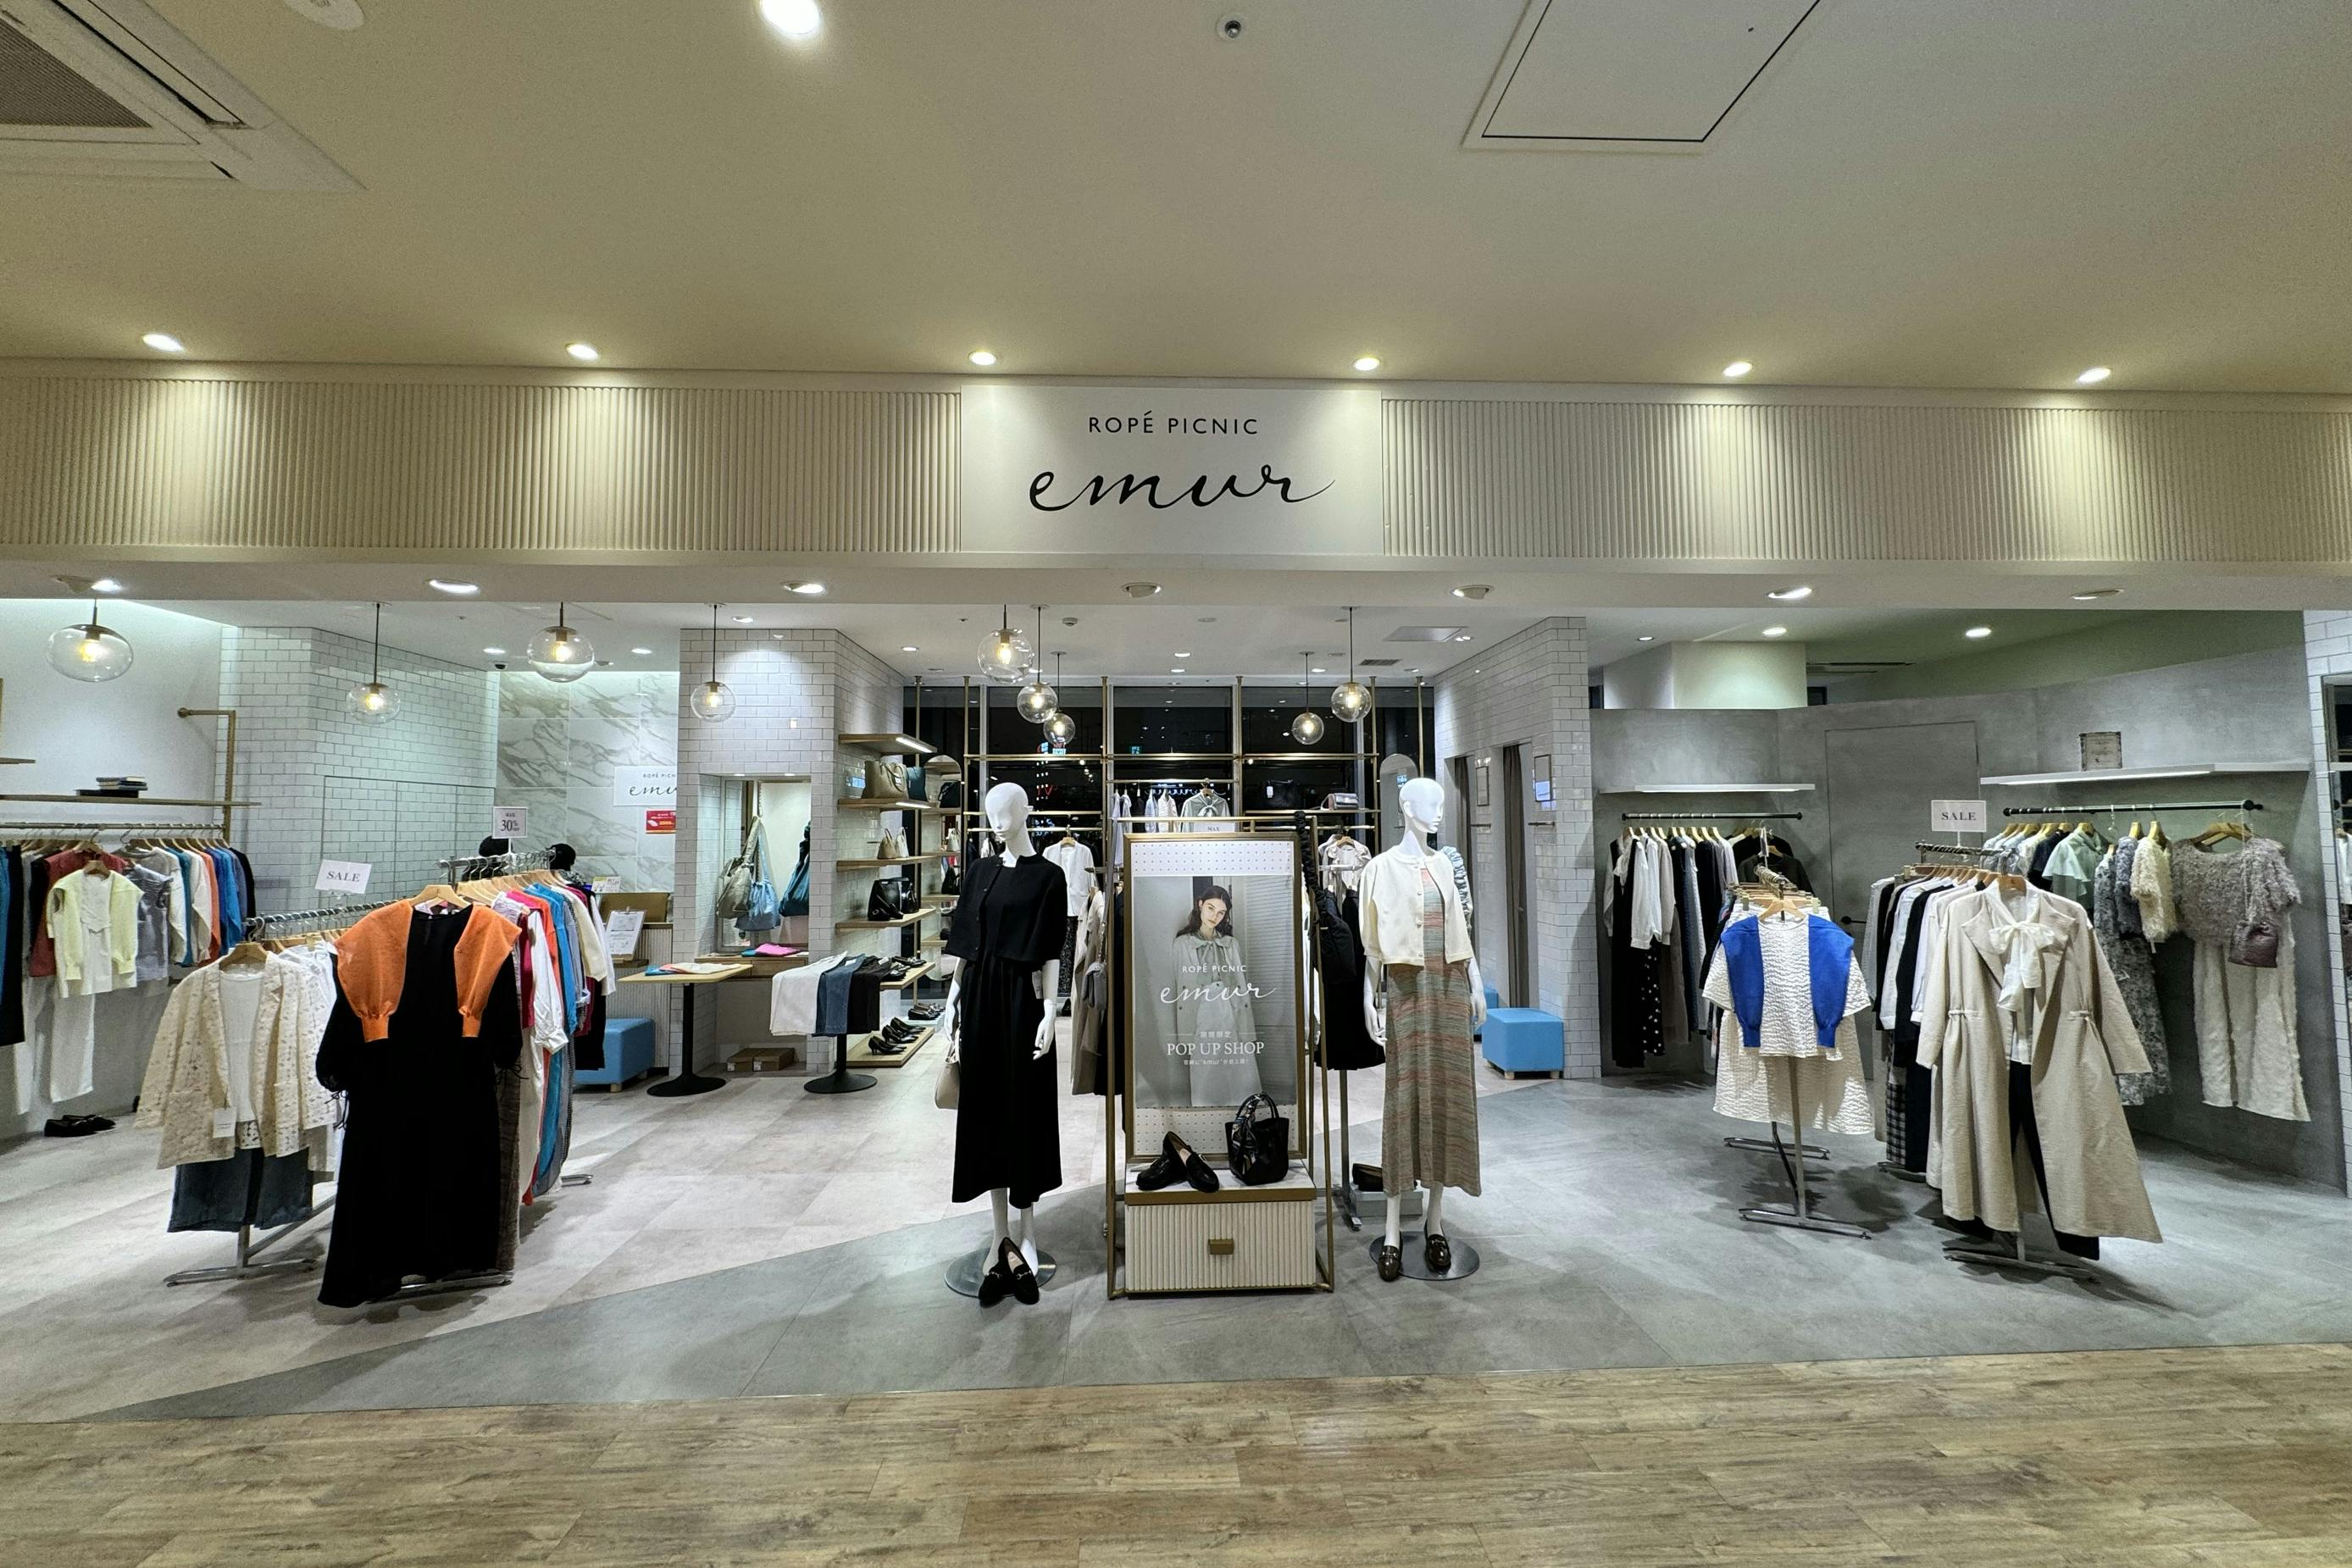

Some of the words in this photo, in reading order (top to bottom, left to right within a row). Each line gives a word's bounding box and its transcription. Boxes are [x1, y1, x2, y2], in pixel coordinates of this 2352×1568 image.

[1089, 410, 1154, 434] ROPÉ
[1168, 418, 1259, 435] PICNIC
[1029, 463, 1336, 512] emur
[1941, 812, 1977, 821] SALE
[326, 871, 361, 883] SALE
[1182, 963, 1207, 972] ROPÉ
[1160, 983, 1277, 1004] emur
[1167, 1043, 1196, 1055] POP
[1200, 1042, 1221, 1055] UP
[1224, 1041, 1265, 1055] SHOP
